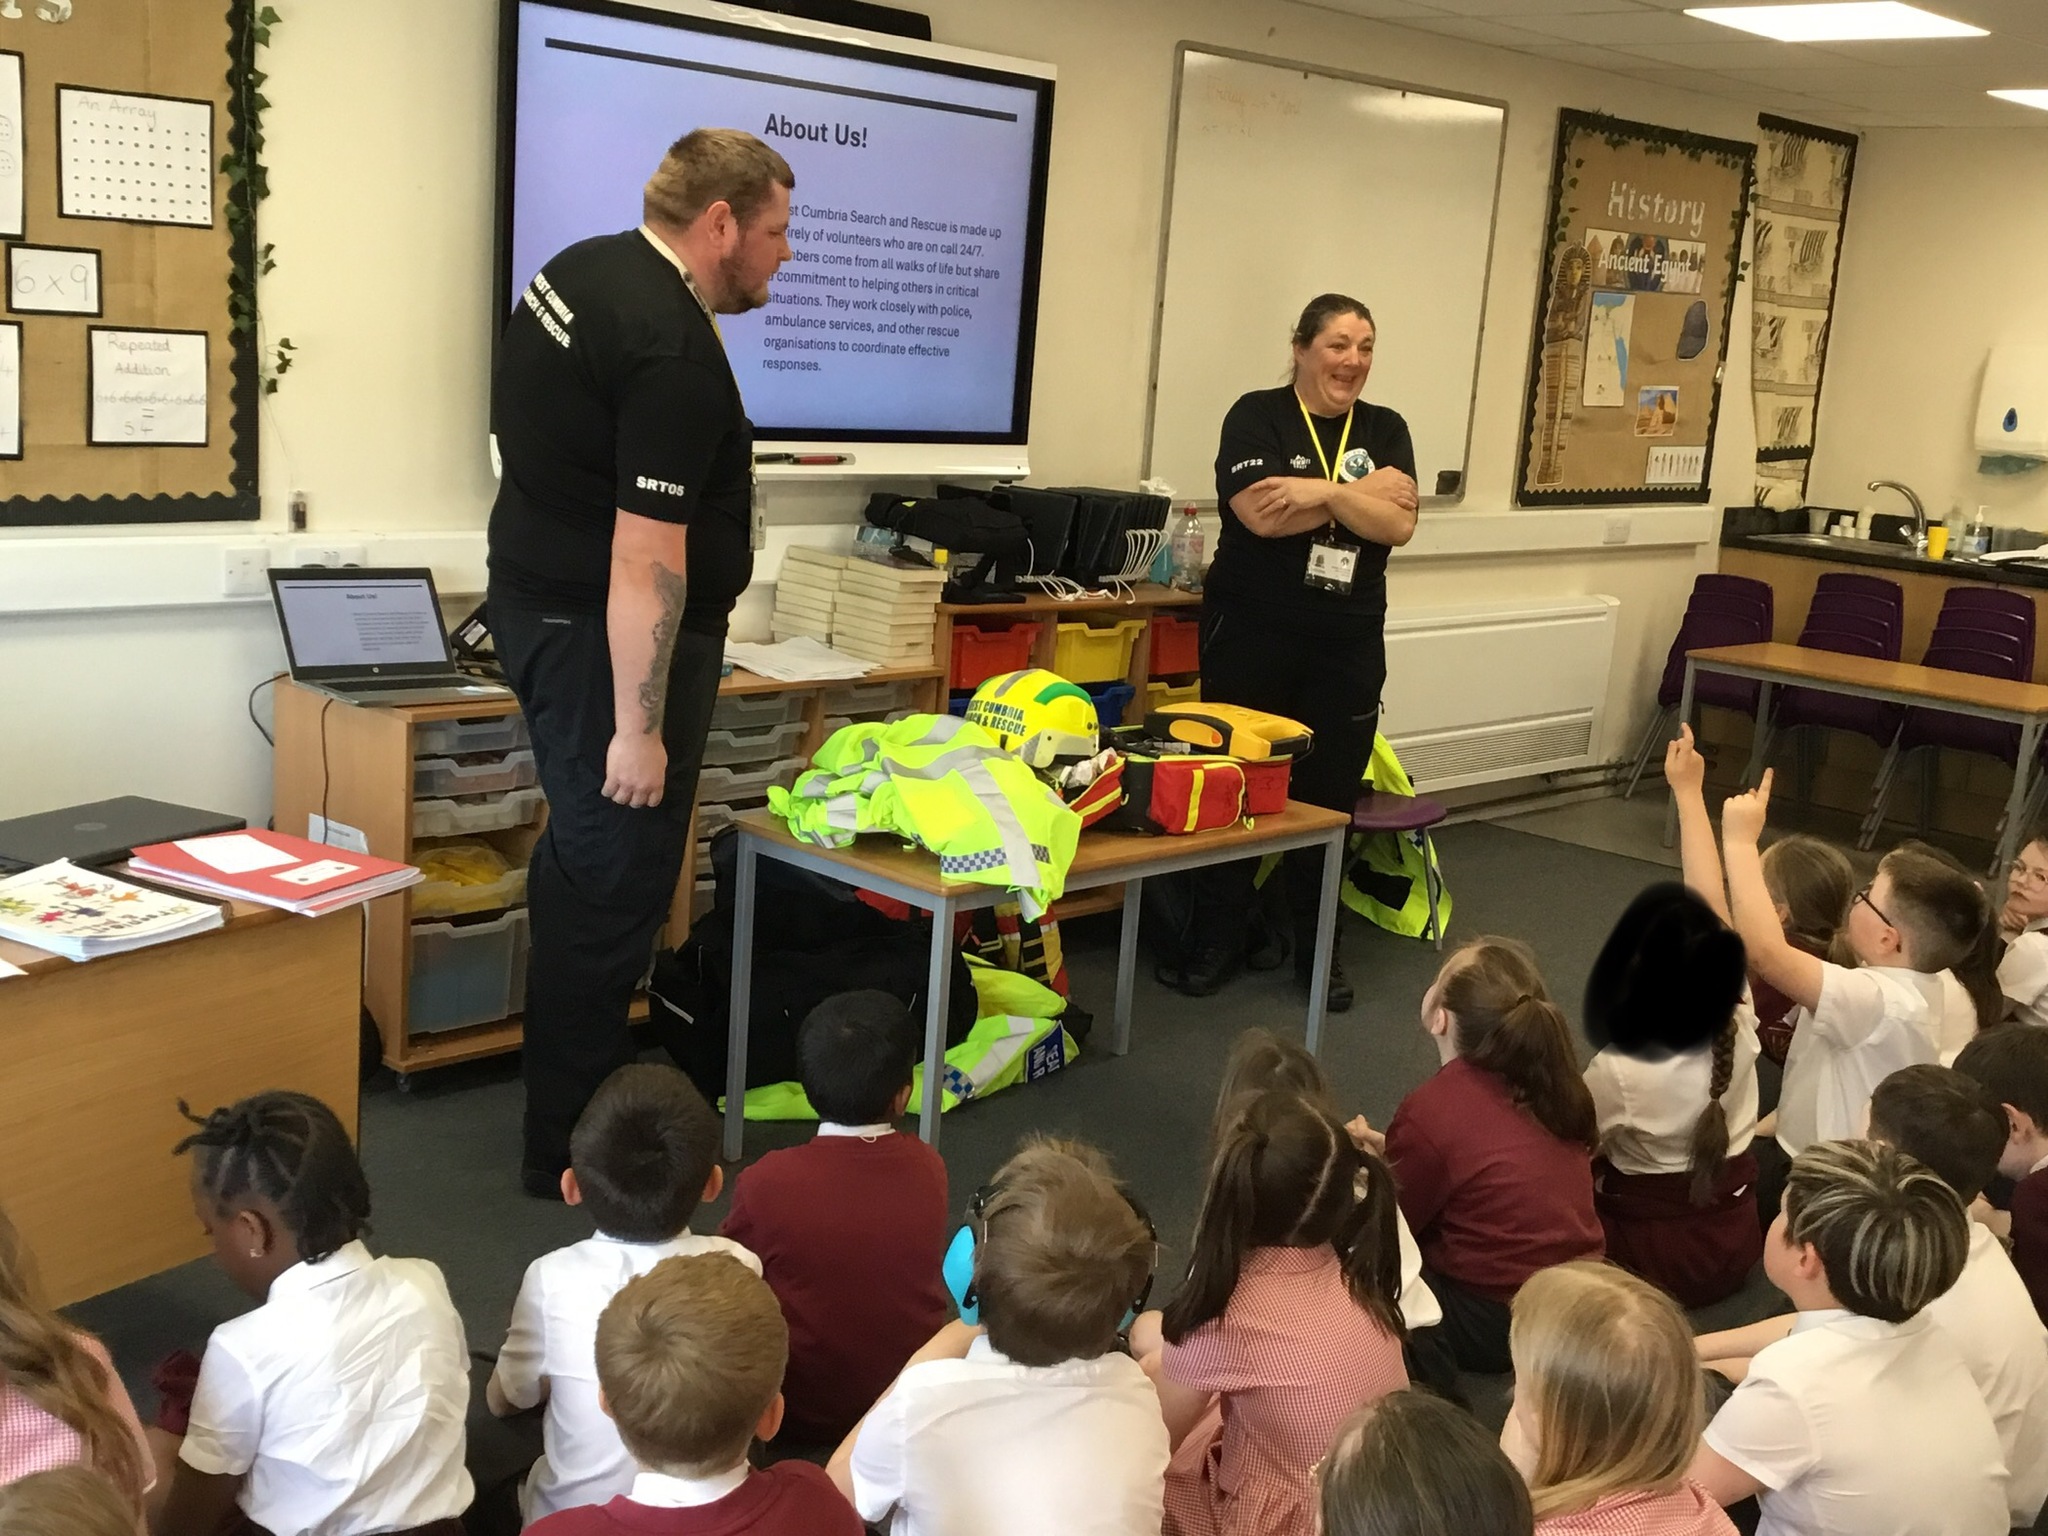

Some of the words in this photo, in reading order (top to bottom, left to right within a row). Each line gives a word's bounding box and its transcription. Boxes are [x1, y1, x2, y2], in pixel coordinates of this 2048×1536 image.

[764, 113, 828, 143] About
[835, 123, 867, 148] Us!
[1608, 181, 1705, 238] History
[801, 205, 848, 221] Cumbria
[850, 210, 887, 226] Search
[889, 216, 908, 229] and
[911, 217, 947, 232] Rescue
[949, 221, 958, 234] is
[960, 225, 987, 237] made
[989, 227, 1002, 240] up
[787, 227, 810, 242] irely
[813, 229, 824, 242] of
[826, 231, 881, 247] volunteers
[883, 236, 905, 250] who
[907, 240, 923, 251] are
[925, 243, 938, 253] on
[940, 243, 958, 255] call
[960, 244, 984, 257] 24/7.
[822, 254, 852, 266] come
[855, 255, 879, 268] from
[881, 258, 893, 269] all
[896, 260, 924, 272] walks
[926, 262, 937, 273] of
[939, 262, 953, 275] life
[956, 264, 971, 276] but
[974, 266, 1000, 279] share
[1598, 248, 1649, 273] Ancient
[14, 260, 35, 293] 6
[70, 264, 88, 301] 9
[777, 271, 846, 286] commitment
[849, 277, 859, 288] to
[862, 277, 899, 294] helping
[901, 281, 932, 294] others
[935, 283, 944, 294] in
[946, 284, 979, 297] critical
[767, 291, 822, 307] situations.
[826, 295, 850, 311] They
[852, 299, 877, 311] work
[880, 300, 915, 315] closely
[918, 303, 938, 315] with
[940, 305, 972, 319] police,
[541, 312, 571, 348] RESCUE
[765, 314, 826, 329] ambulance
[829, 319, 874, 333] services,
[877, 322, 896, 333] and
[898, 323, 925, 335] other
[927, 326, 960, 337] rescue
[108, 332, 171, 355] Repeated
[764, 337, 836, 351] organisations
[839, 340, 849, 351] to
[851, 342, 906, 355] coordinate
[908, 343, 950, 357] effective
[115, 362, 171, 376] Addition
[762, 359, 821, 371] responses.
[1231, 458, 1263, 473] SRT22
[636, 475, 685, 496] SRT05
[983, 700, 1024, 722] CUMBRIA
[982, 715, 989, 727] &
[990, 716, 1026, 736] RESCUE
